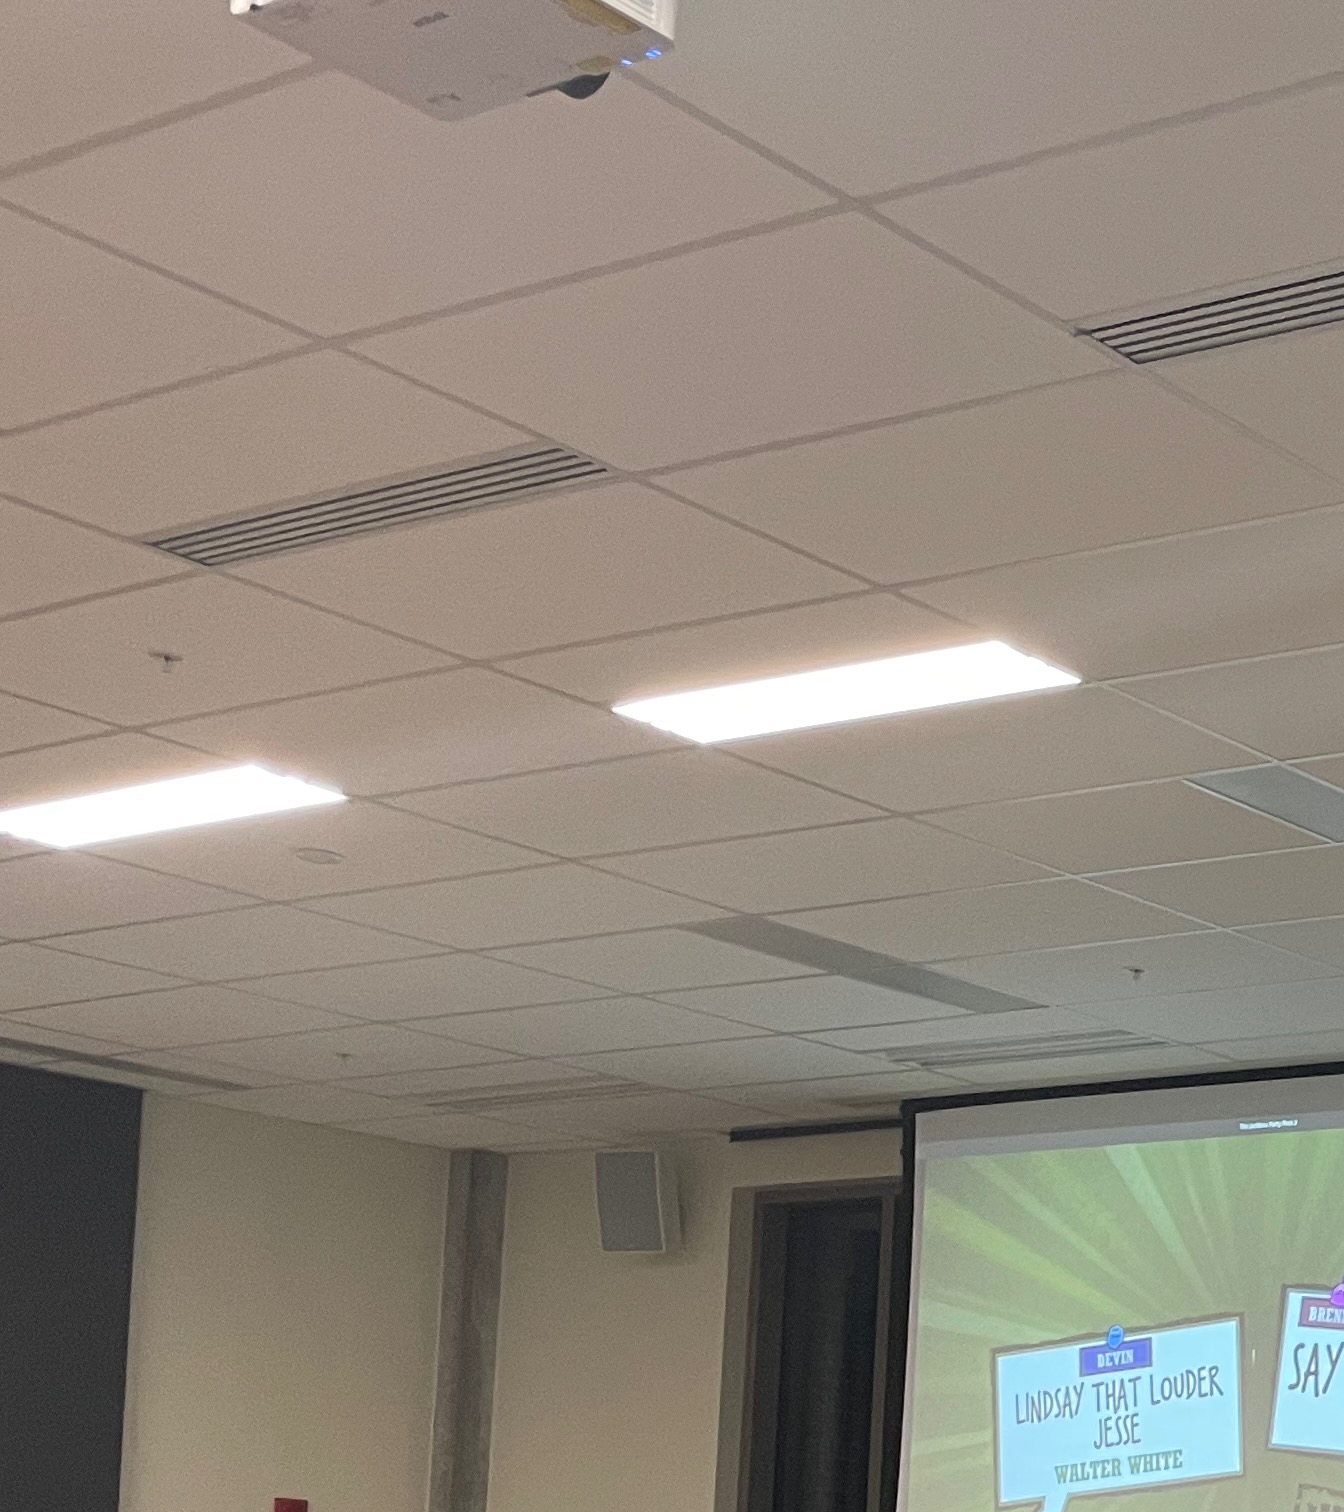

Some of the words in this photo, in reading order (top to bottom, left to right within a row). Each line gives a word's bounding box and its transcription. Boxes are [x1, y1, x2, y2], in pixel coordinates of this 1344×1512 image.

[1097, 1349, 1134, 1368] DEVIN
[1287, 1341, 1344, 1398] SAY
[1015, 1382, 1084, 1424] LINDSAY
[1091, 1375, 1142, 1414] THAT
[1150, 1365, 1224, 1405] LOUDER
[1093, 1412, 1141, 1449] JESSE
[1054, 1457, 1122, 1485] WALTER
[1127, 1449, 1183, 1475] WHITE
